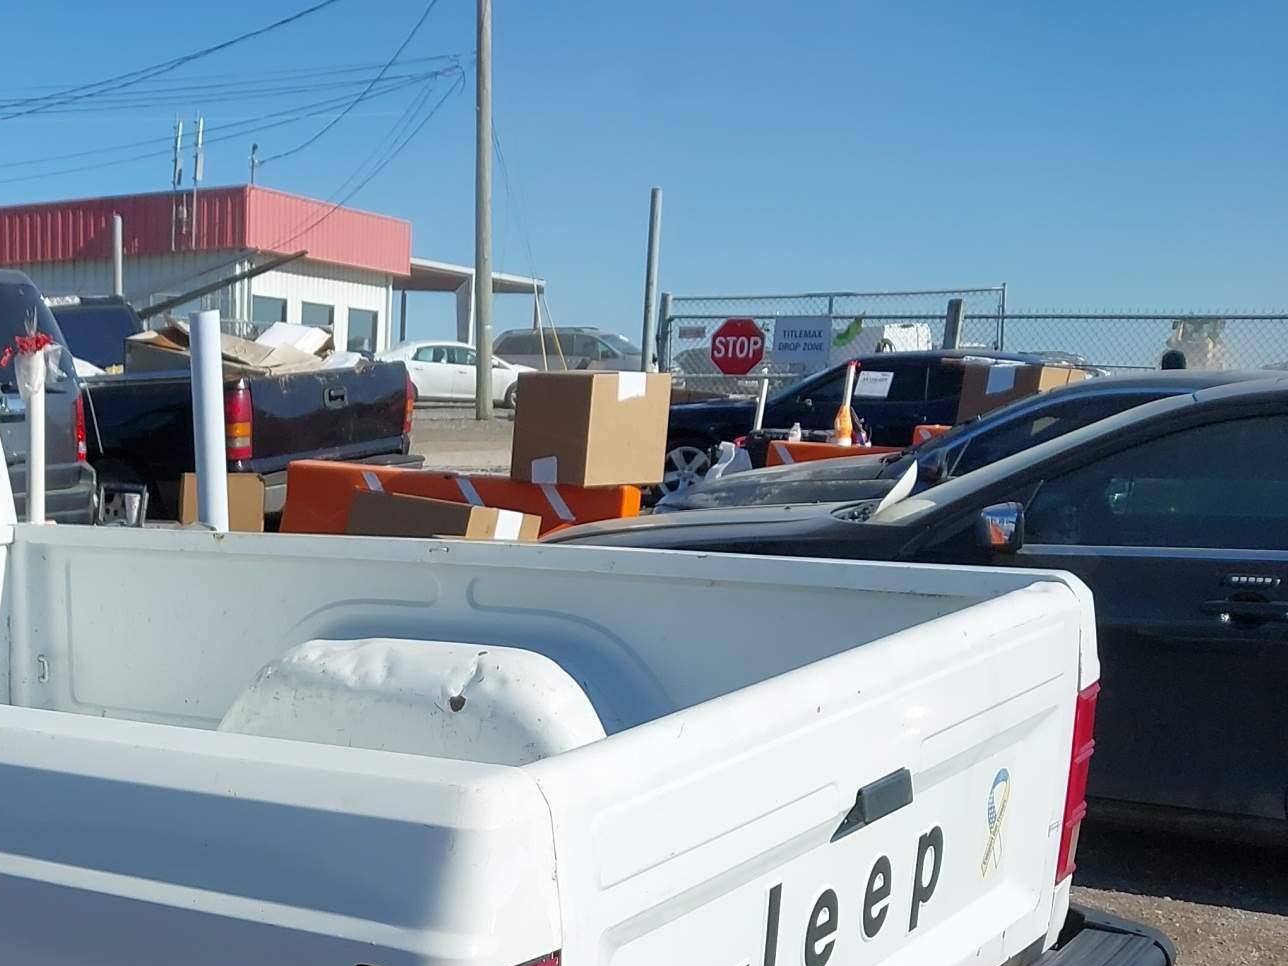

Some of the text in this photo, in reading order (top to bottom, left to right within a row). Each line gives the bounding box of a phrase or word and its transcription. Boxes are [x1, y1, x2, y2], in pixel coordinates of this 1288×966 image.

[783, 329, 822, 338] TITLEMAX
[714, 336, 761, 358] STOP
[778, 342, 823, 351] DROP ZONE
